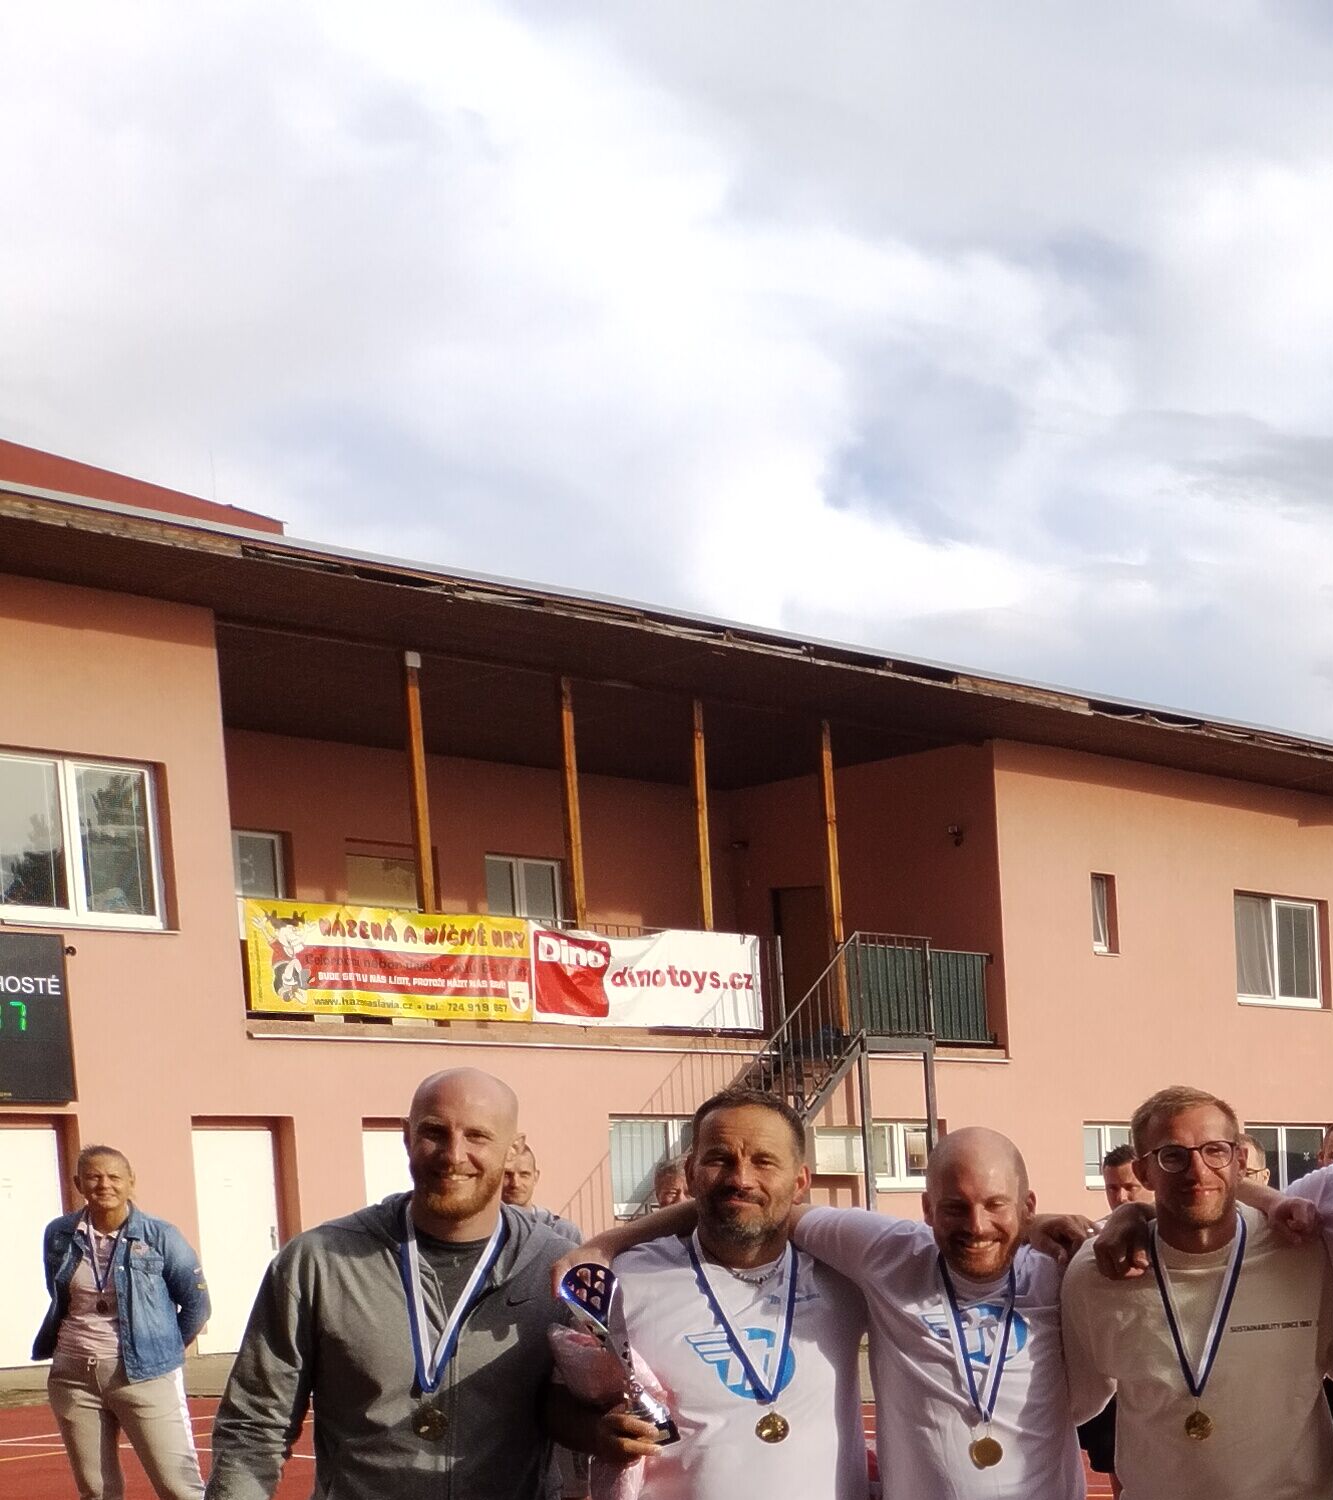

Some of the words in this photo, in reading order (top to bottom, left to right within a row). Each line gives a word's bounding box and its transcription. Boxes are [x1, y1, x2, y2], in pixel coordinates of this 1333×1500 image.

[403, 925, 418, 944] A
[538, 935, 605, 968] Dino
[611, 965, 754, 994] dinotoys.cz
